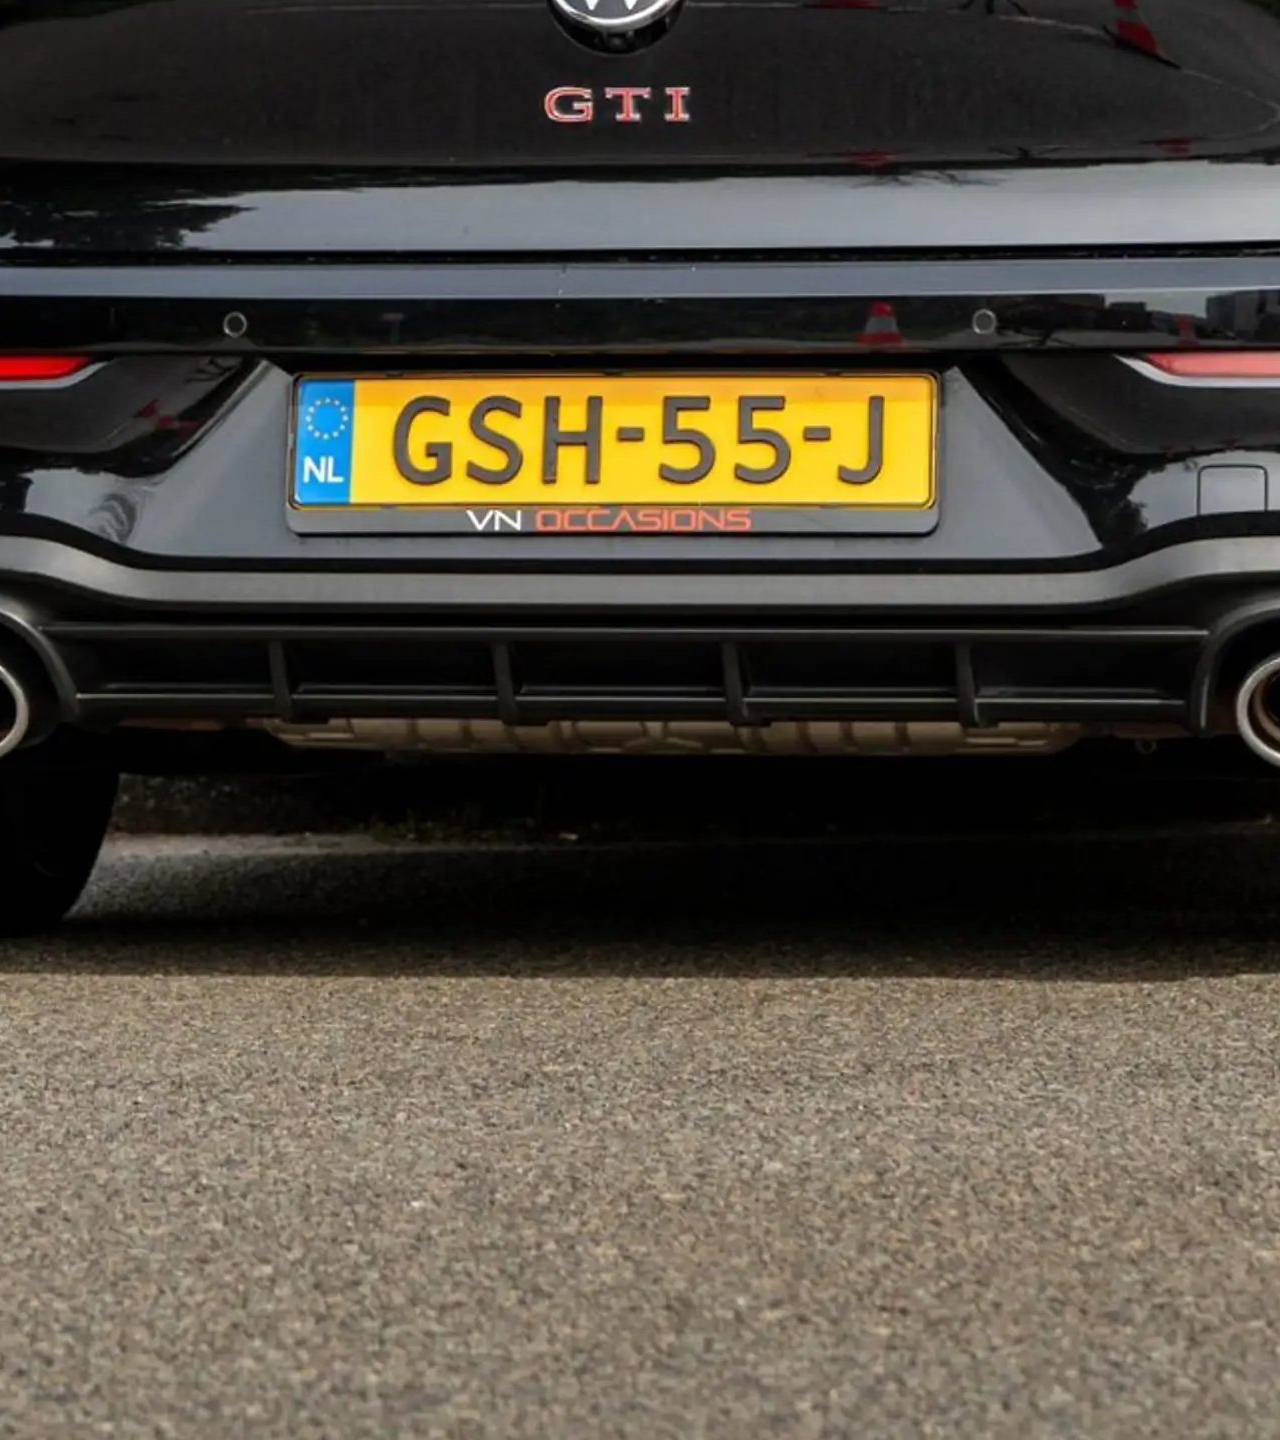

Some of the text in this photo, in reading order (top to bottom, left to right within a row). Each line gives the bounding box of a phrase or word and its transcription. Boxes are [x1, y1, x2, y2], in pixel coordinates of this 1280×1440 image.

[543, 86, 691, 123] GTI
[391, 393, 886, 486] GSH-55-J
[302, 456, 345, 485] NL
[466, 507, 753, 532] VN OCCASIONS
